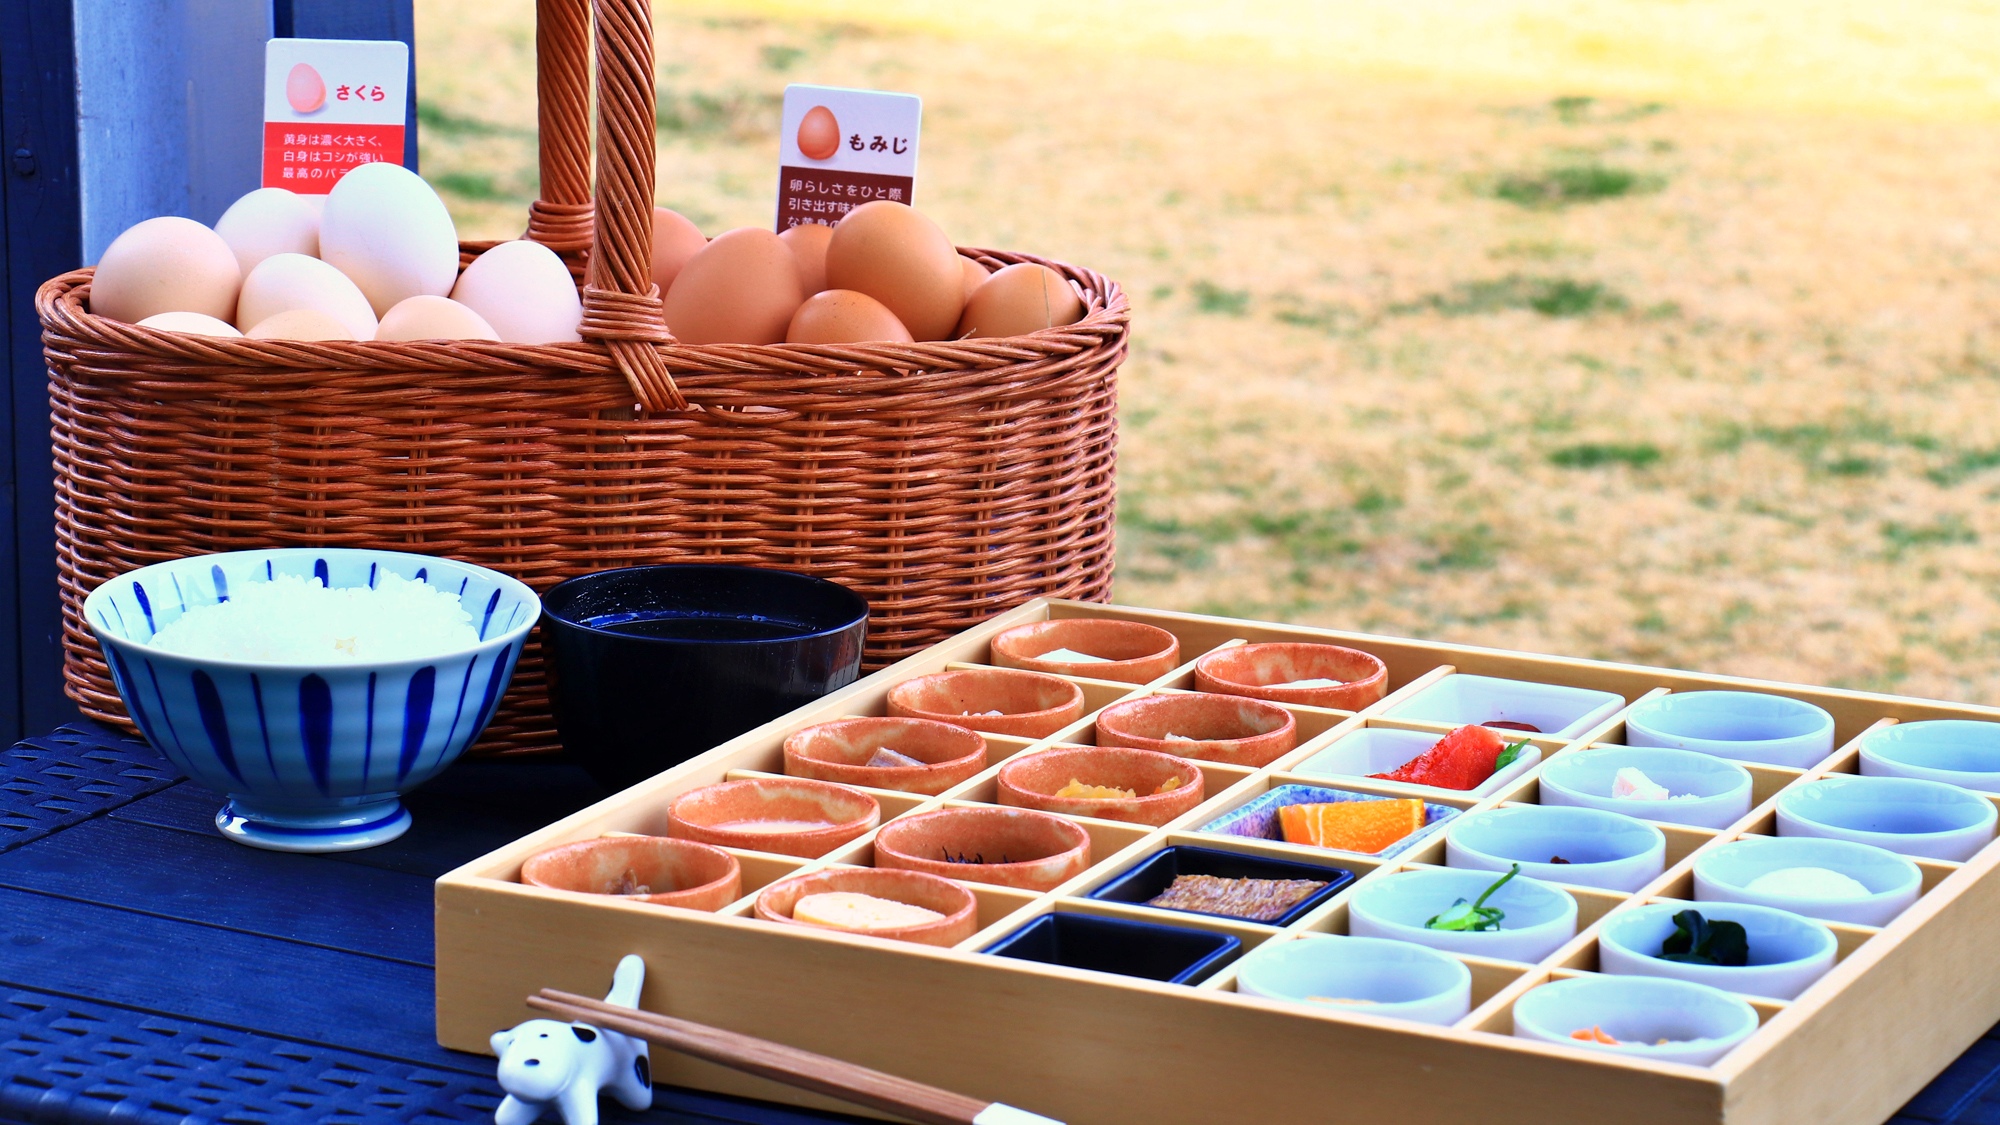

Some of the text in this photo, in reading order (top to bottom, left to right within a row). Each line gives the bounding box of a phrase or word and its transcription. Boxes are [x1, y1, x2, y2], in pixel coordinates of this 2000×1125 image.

[336, 84, 385, 102] さくら
[283, 133, 382, 147] 黄身は濃く大きく、
[849, 134, 908, 155] もみじ
[283, 151, 384, 164] 白身はコシが強い
[789, 178, 902, 200] 卵らしさをひと際
